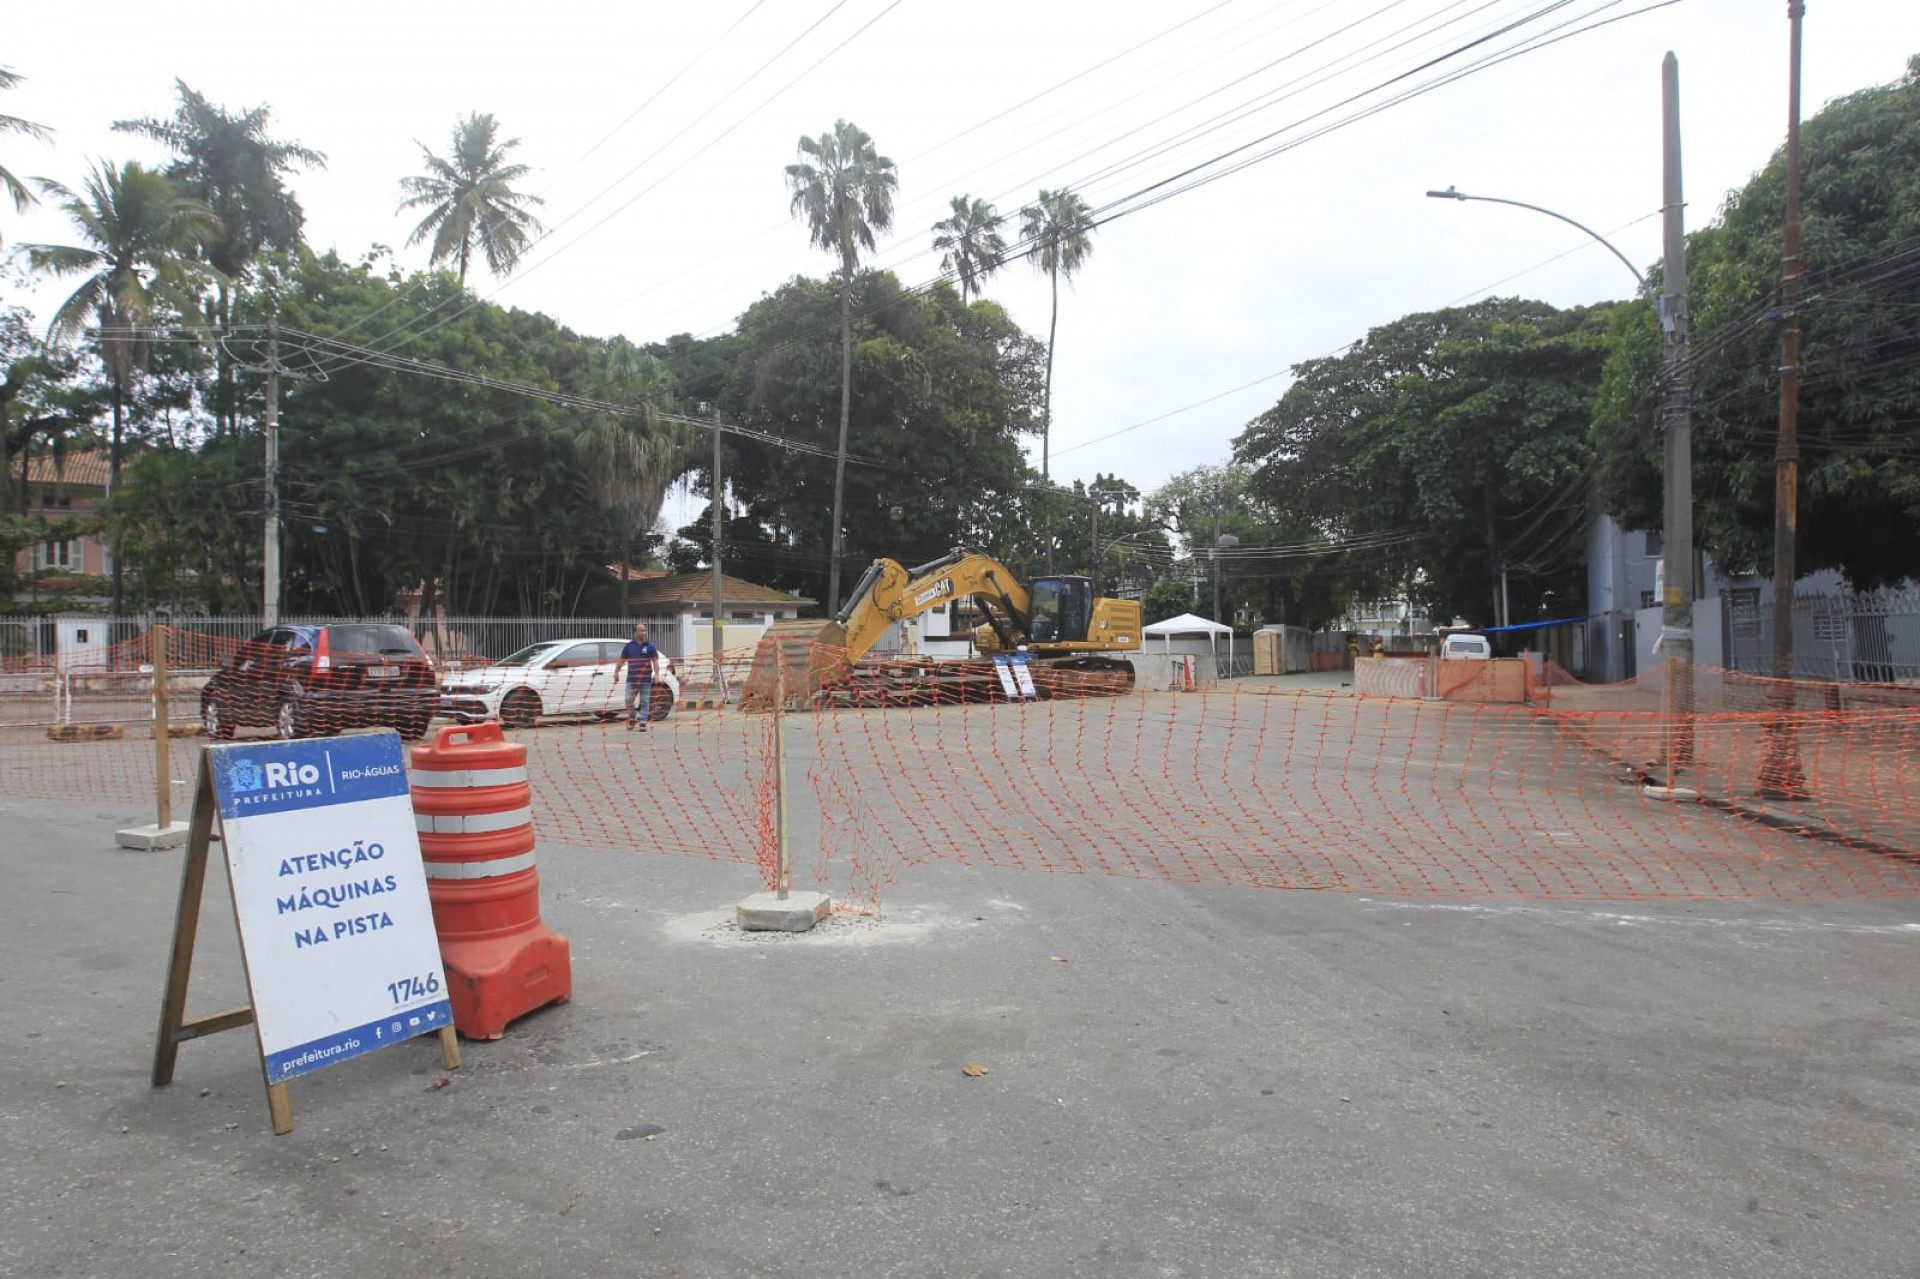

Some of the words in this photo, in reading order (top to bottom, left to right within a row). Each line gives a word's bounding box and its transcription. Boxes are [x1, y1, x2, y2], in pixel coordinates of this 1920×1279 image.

[935, 577, 950, 597] CAT
[265, 762, 319, 788] Rio
[341, 764, 400, 781] RIO-ÁGUAS
[233, 788, 323, 806] PREFEITURA
[279, 840, 384, 877] ATENÇÃO
[276, 875, 397, 914] MÁQUINAS
[294, 926, 329, 948] NA
[334, 912, 394, 939] PISTA
[388, 972, 439, 1004] 1746
[282, 1038, 361, 1073] prefeitura.rio
